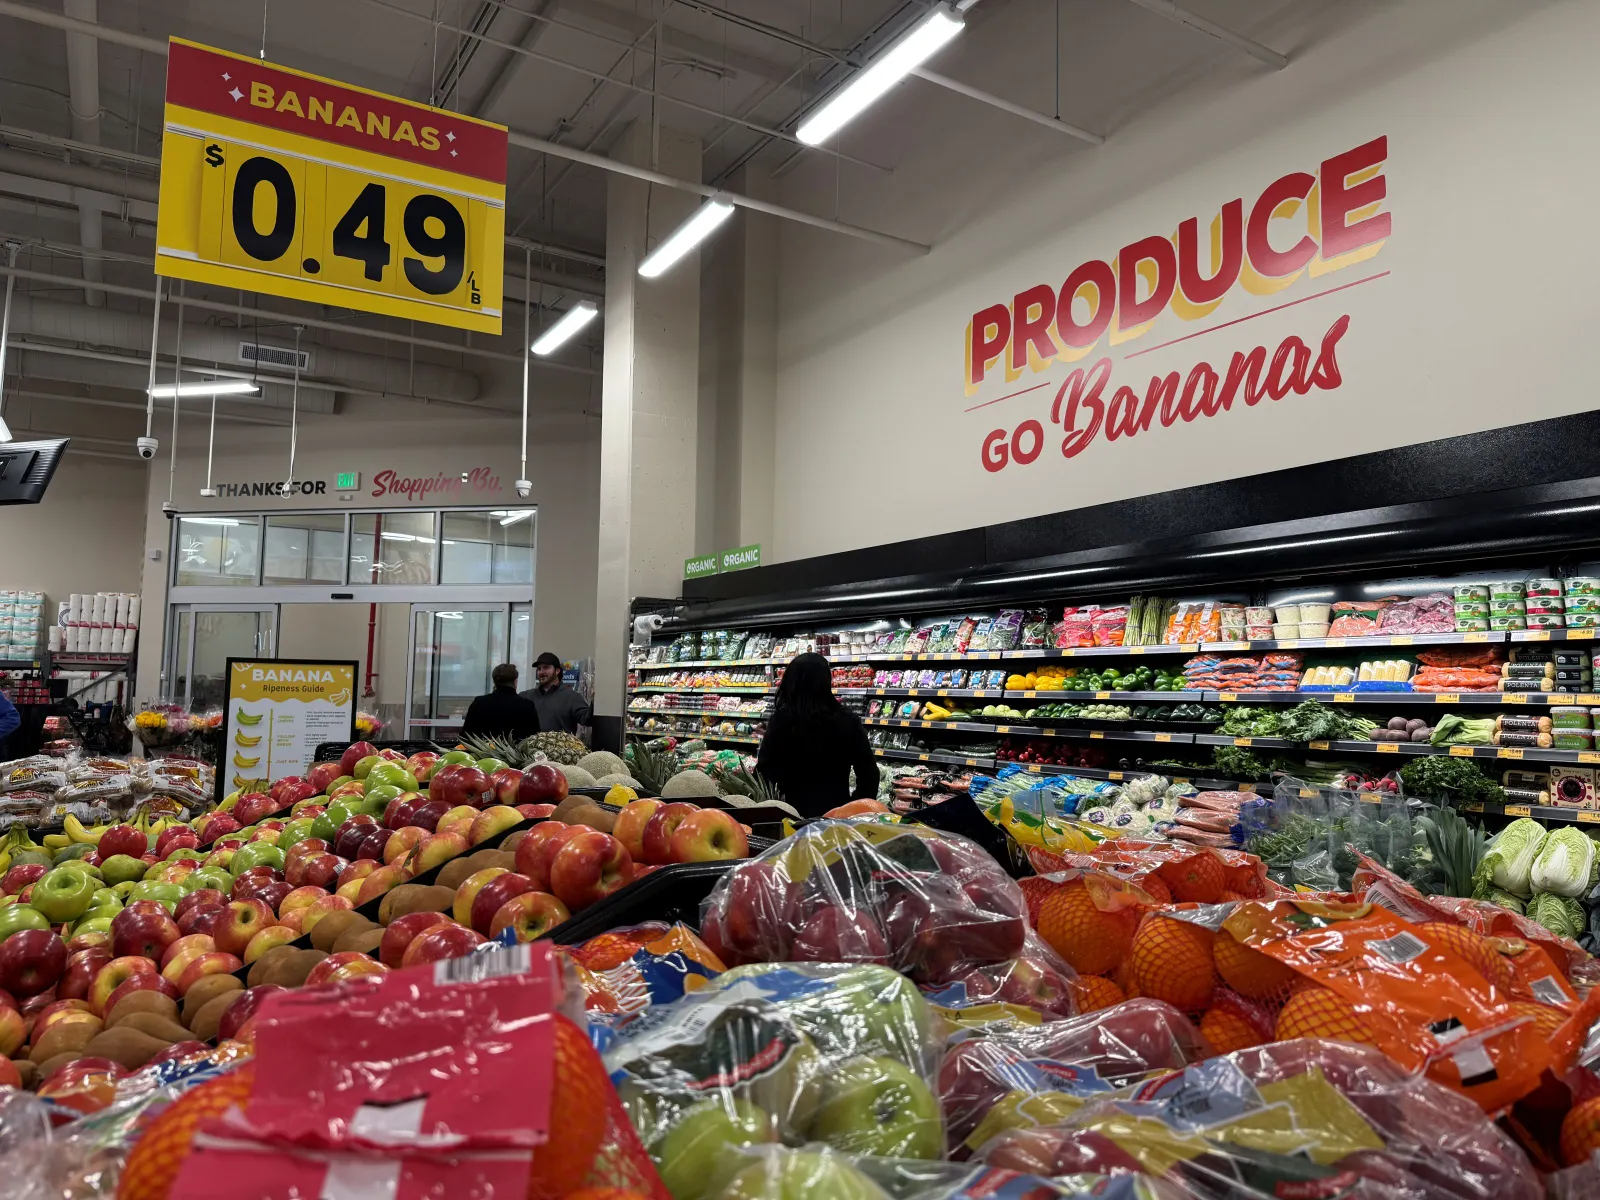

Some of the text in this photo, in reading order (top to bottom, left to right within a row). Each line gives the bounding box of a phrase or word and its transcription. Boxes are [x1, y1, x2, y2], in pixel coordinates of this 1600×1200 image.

[250, 81, 441, 151] BANANAS
[965, 134, 1392, 394] PRODUCE
[981, 314, 1351, 473] GO Bananas
[337, 472, 356, 488] EXIT
[216, 482, 285, 498] THANKS
[290, 480, 327, 496] FOR
[723, 549, 758, 566] ORGANIC
[686, 558, 716, 574] ORGANIC
[252, 668, 335, 683] BANANA
[263, 684, 325, 694] Ripeness Guide
[1503, 719, 1536, 727] POLENTA
